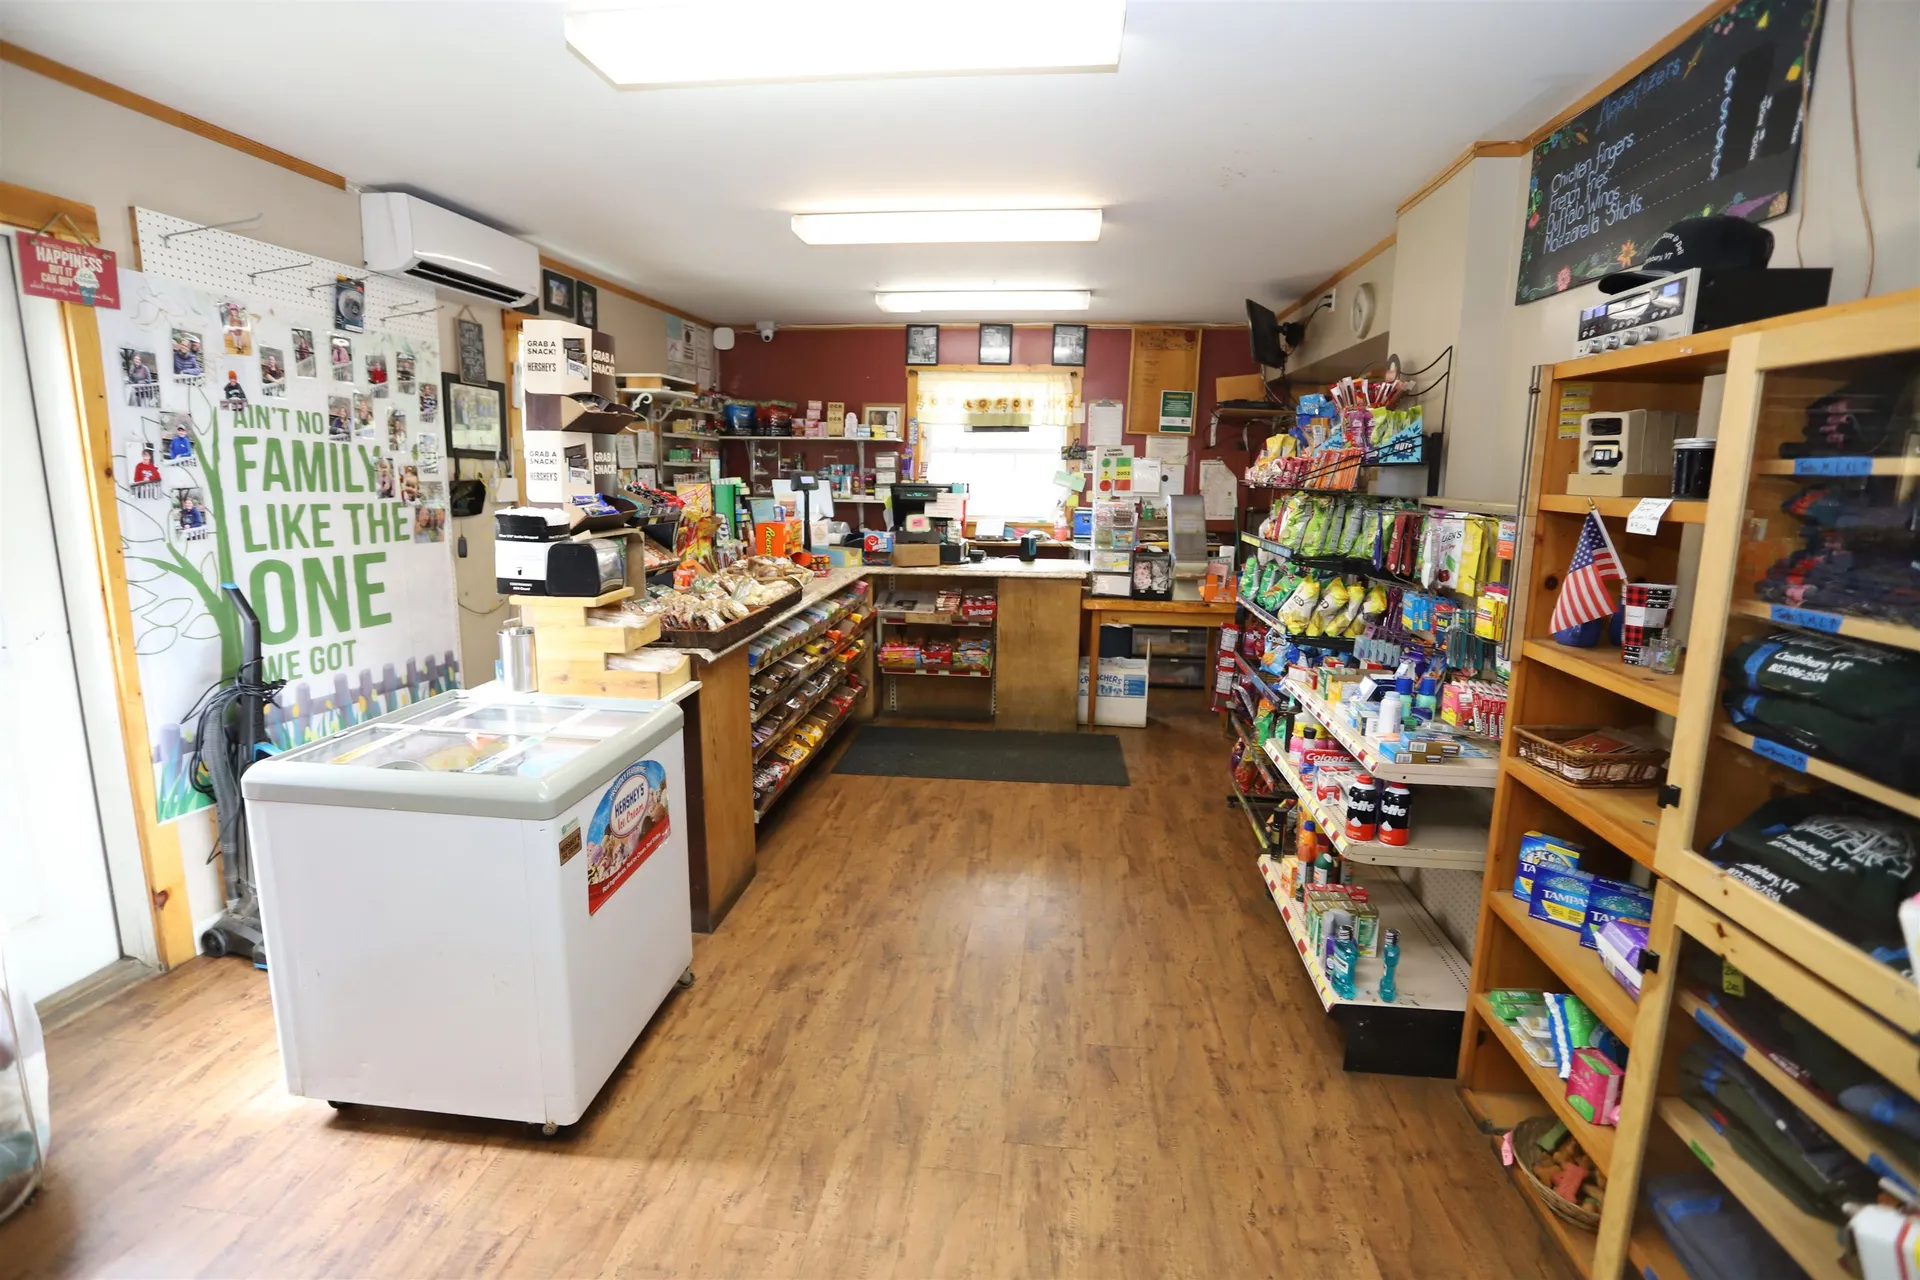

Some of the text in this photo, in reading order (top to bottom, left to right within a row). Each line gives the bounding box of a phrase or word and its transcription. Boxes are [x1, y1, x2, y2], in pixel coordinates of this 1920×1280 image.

[1594, 57, 1682, 134] Appetizers
[1551, 157, 1592, 193] Chicken
[1548, 188, 1580, 214] French
[1547, 203, 1585, 237] Buffalo
[1543, 215, 1599, 254] Mozzarella
[35, 245, 104, 274] HAPPINESS
[48, 264, 64, 275] BUT
[40, 272, 57, 283] CAN
[527, 340, 548, 348] GRAB
[592, 349, 610, 363] GRAB
[527, 362, 557, 373] HERSHEY'S
[592, 362, 615, 377] SNACK!
[233, 404, 324, 435] AIN'T NO
[233, 436, 381, 493] FAMILY
[594, 451, 610, 463] GRAB
[594, 463, 616, 475] SNACK!
[529, 472, 558, 482] HERSHEY'S
[240, 501, 411, 553] LIKE THE
[249, 551, 393, 645] ONE
[262, 639, 357, 682] WE GOT
[1774, 651, 1829, 672] Craftsbury,
[1831, 660, 1855, 672] VT
[1305, 752, 1351, 763] Colgate
[614, 783, 645, 818] HERSHEY'S
[617, 803, 644, 831] Ice Cream
[1781, 877, 1800, 894] VT
